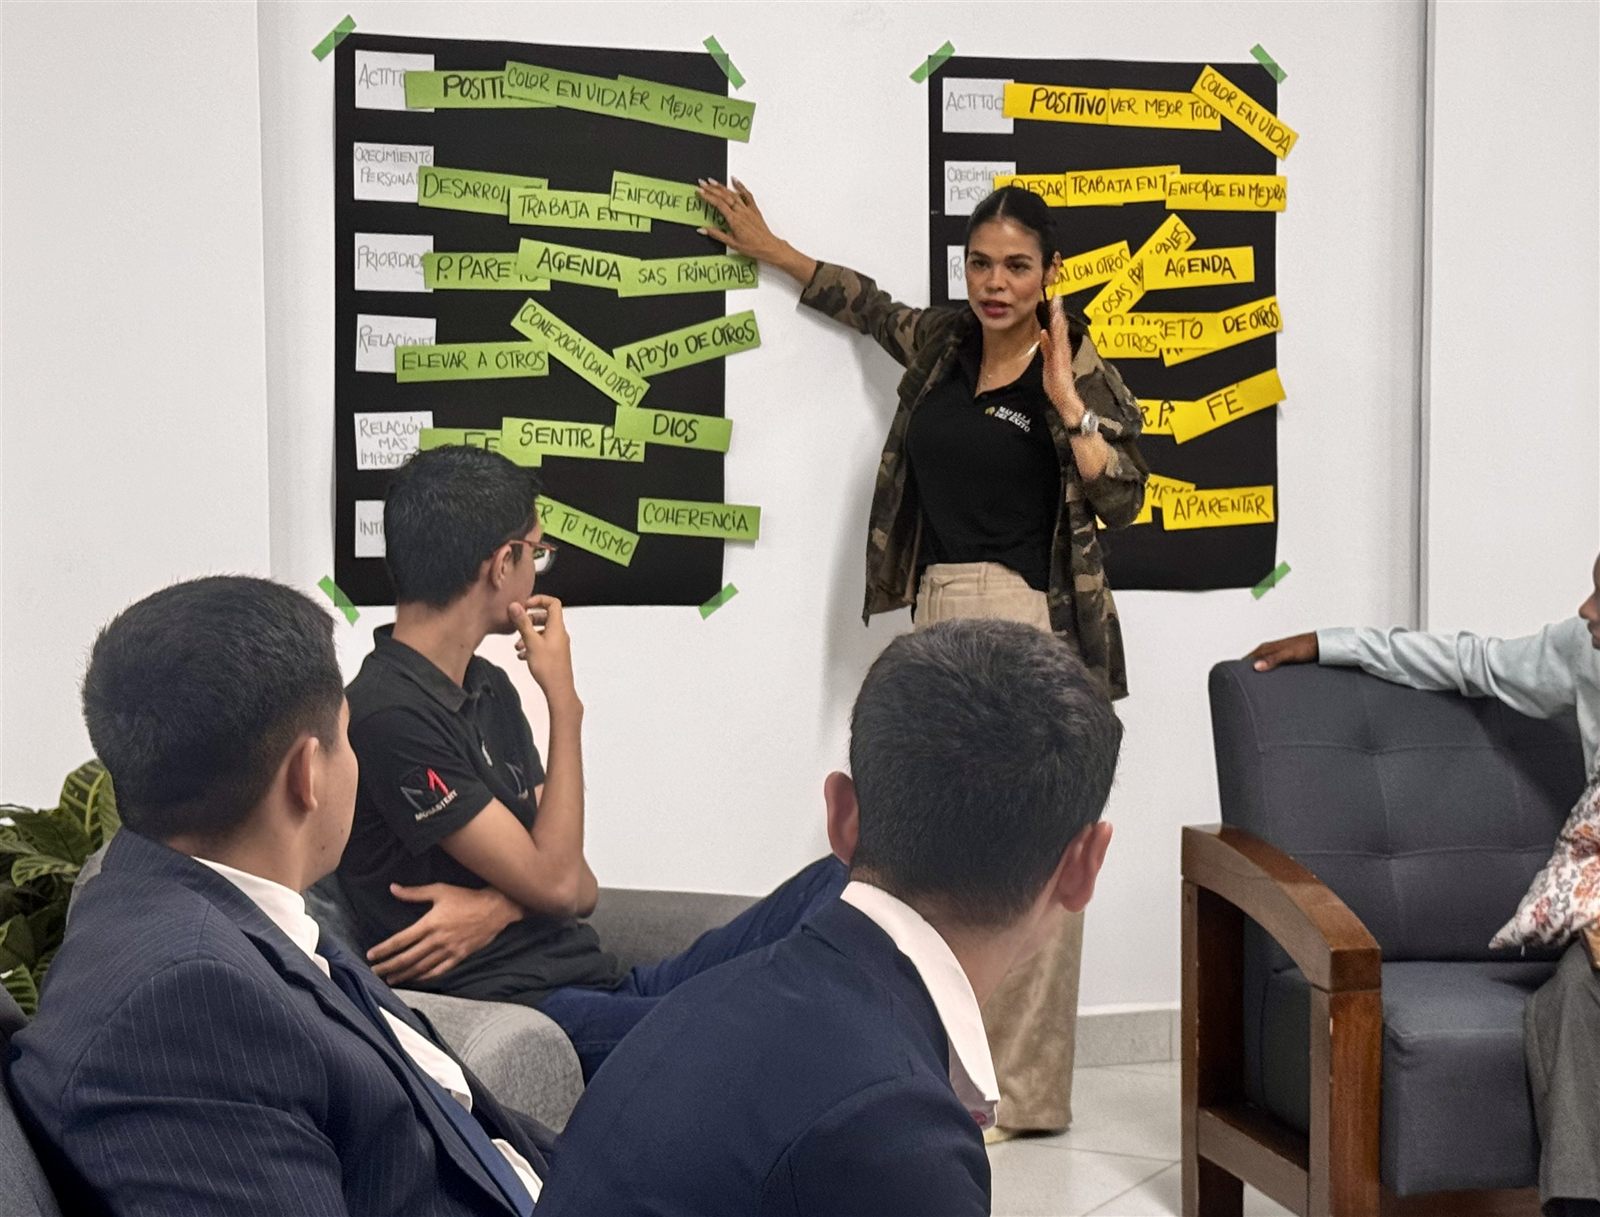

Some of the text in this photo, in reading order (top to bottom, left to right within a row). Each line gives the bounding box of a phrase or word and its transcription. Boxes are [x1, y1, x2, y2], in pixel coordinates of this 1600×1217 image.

[507, 66, 627, 111] COLOR EN VIDA
[1029, 87, 1107, 116] POSITIVO
[1110, 97, 1138, 115] VER
[1145, 98, 1184, 119] MEJOR
[629, 85, 750, 131] ER MEJOR TODO
[1200, 72, 1292, 156] COLOR EN VIDA
[354, 146, 433, 165] CRECIMIENTO
[612, 181, 683, 210] ENFOQUE
[1071, 175, 1133, 196] TRABAJA
[1136, 175, 1157, 191] EN
[1168, 179, 1287, 208] ENFOQUE EN MEJORA
[518, 193, 590, 219] TRABAJA
[357, 244, 423, 272] PRIORIDAD
[536, 246, 622, 281] AGENDA
[677, 260, 757, 285] PRINCIPALES
[1073, 261, 1094, 281] CON
[1164, 254, 1237, 280] AGENDA
[1222, 302, 1279, 334] DE OTROS
[626, 318, 756, 374] APOYO DE OTROS
[1097, 331, 1108, 348] A
[1114, 332, 1157, 353] OTROS
[402, 350, 546, 372] ELEVAR A OTROS
[582, 351, 609, 377] CON
[605, 372, 644, 407] OTROS
[519, 421, 595, 448] SENTIR
[653, 413, 699, 444] DIOS
[642, 502, 749, 533] COHERENCIA
[1173, 493, 1270, 521] APARENTAR
[581, 523, 633, 556] MISMO
